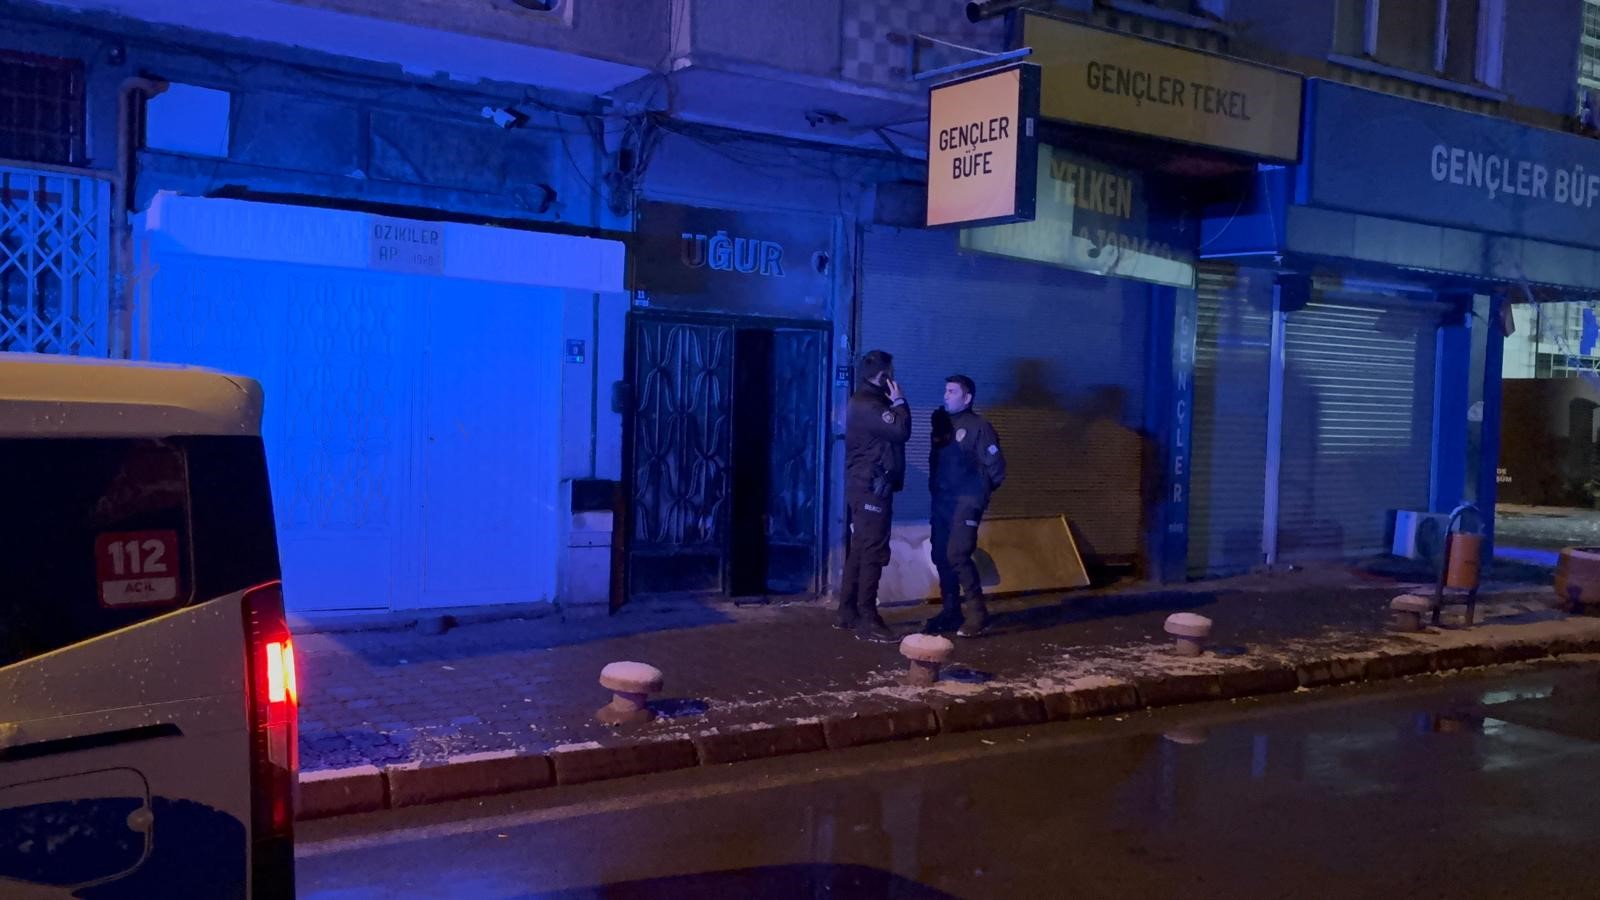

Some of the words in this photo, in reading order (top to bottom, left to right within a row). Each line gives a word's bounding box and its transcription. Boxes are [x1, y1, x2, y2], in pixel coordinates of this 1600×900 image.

[1087, 61, 1184, 107] GENÇLER
[1191, 83, 1251, 121] TEKEL
[939, 116, 1009, 152] GENÇLER
[952, 149, 992, 179] BÜFE
[1431, 144, 1548, 200] GENÇLER
[1050, 157, 1132, 219] YELKEN
[680, 230, 784, 277] UĞUR
[108, 539, 167, 574] 112
